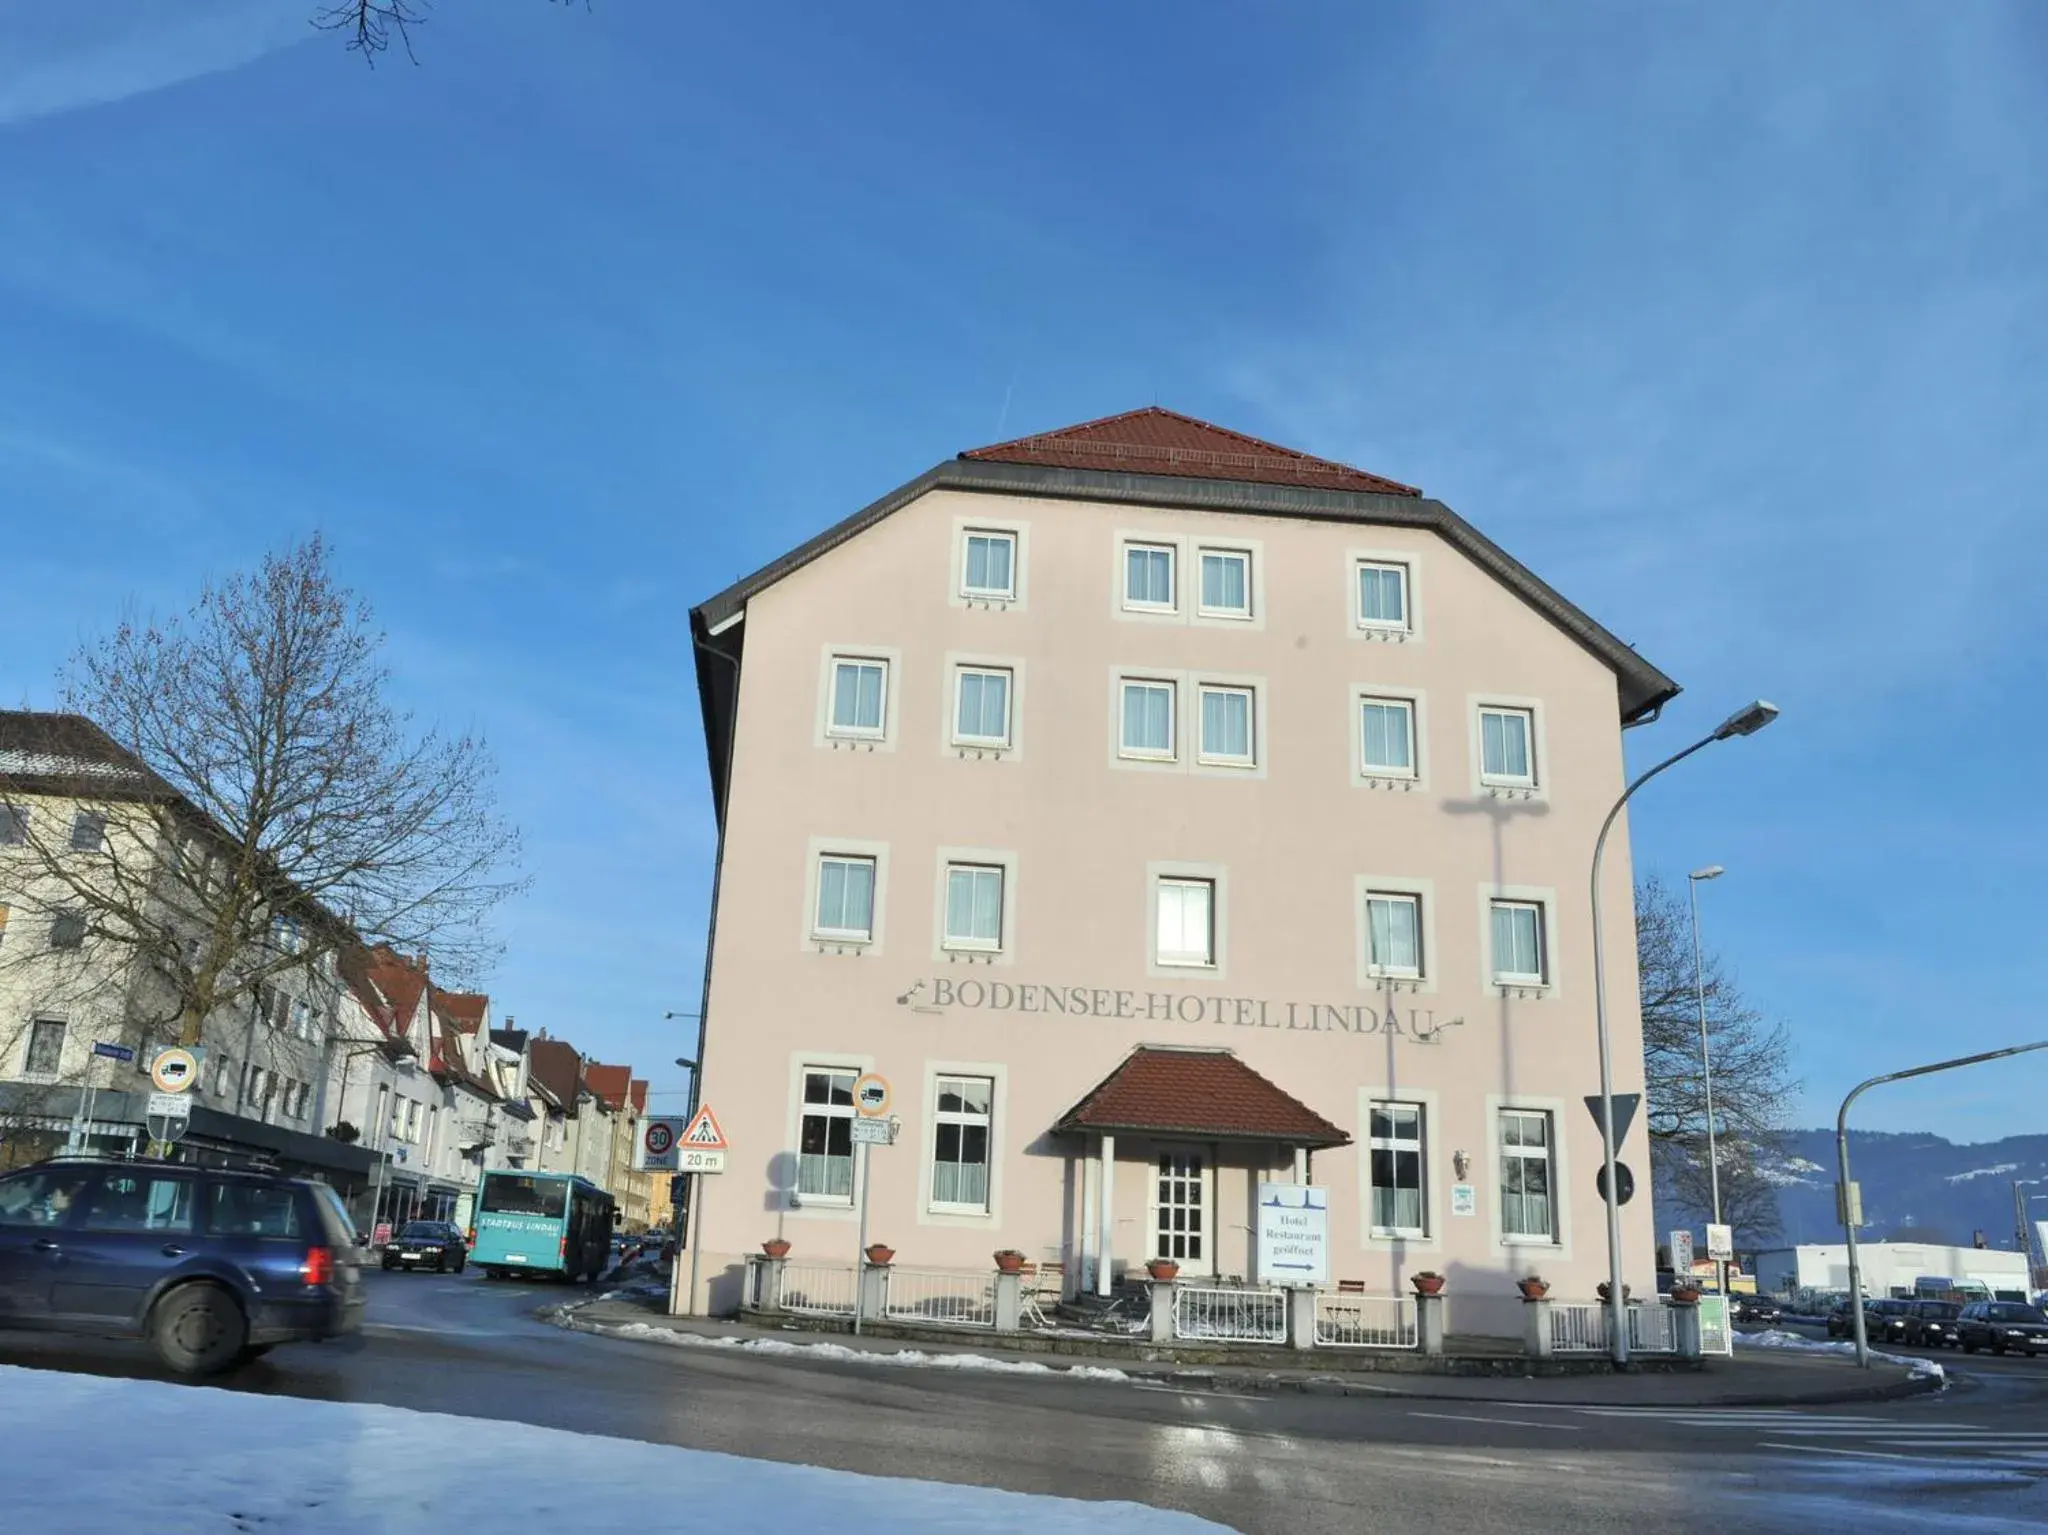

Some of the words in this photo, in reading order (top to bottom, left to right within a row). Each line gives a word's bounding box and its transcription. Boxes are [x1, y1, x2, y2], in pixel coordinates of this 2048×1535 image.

[1285, 1002, 1435, 1037] LINDAU
[651, 1131, 668, 1145] 30
[687, 1154, 702, 1166] 20
[705, 1157, 717, 1167] m
[526, 1221, 560, 1232] LINDAU
[1280, 1214, 1308, 1227] Hotel
[1266, 1228, 1322, 1242] Restaurant
